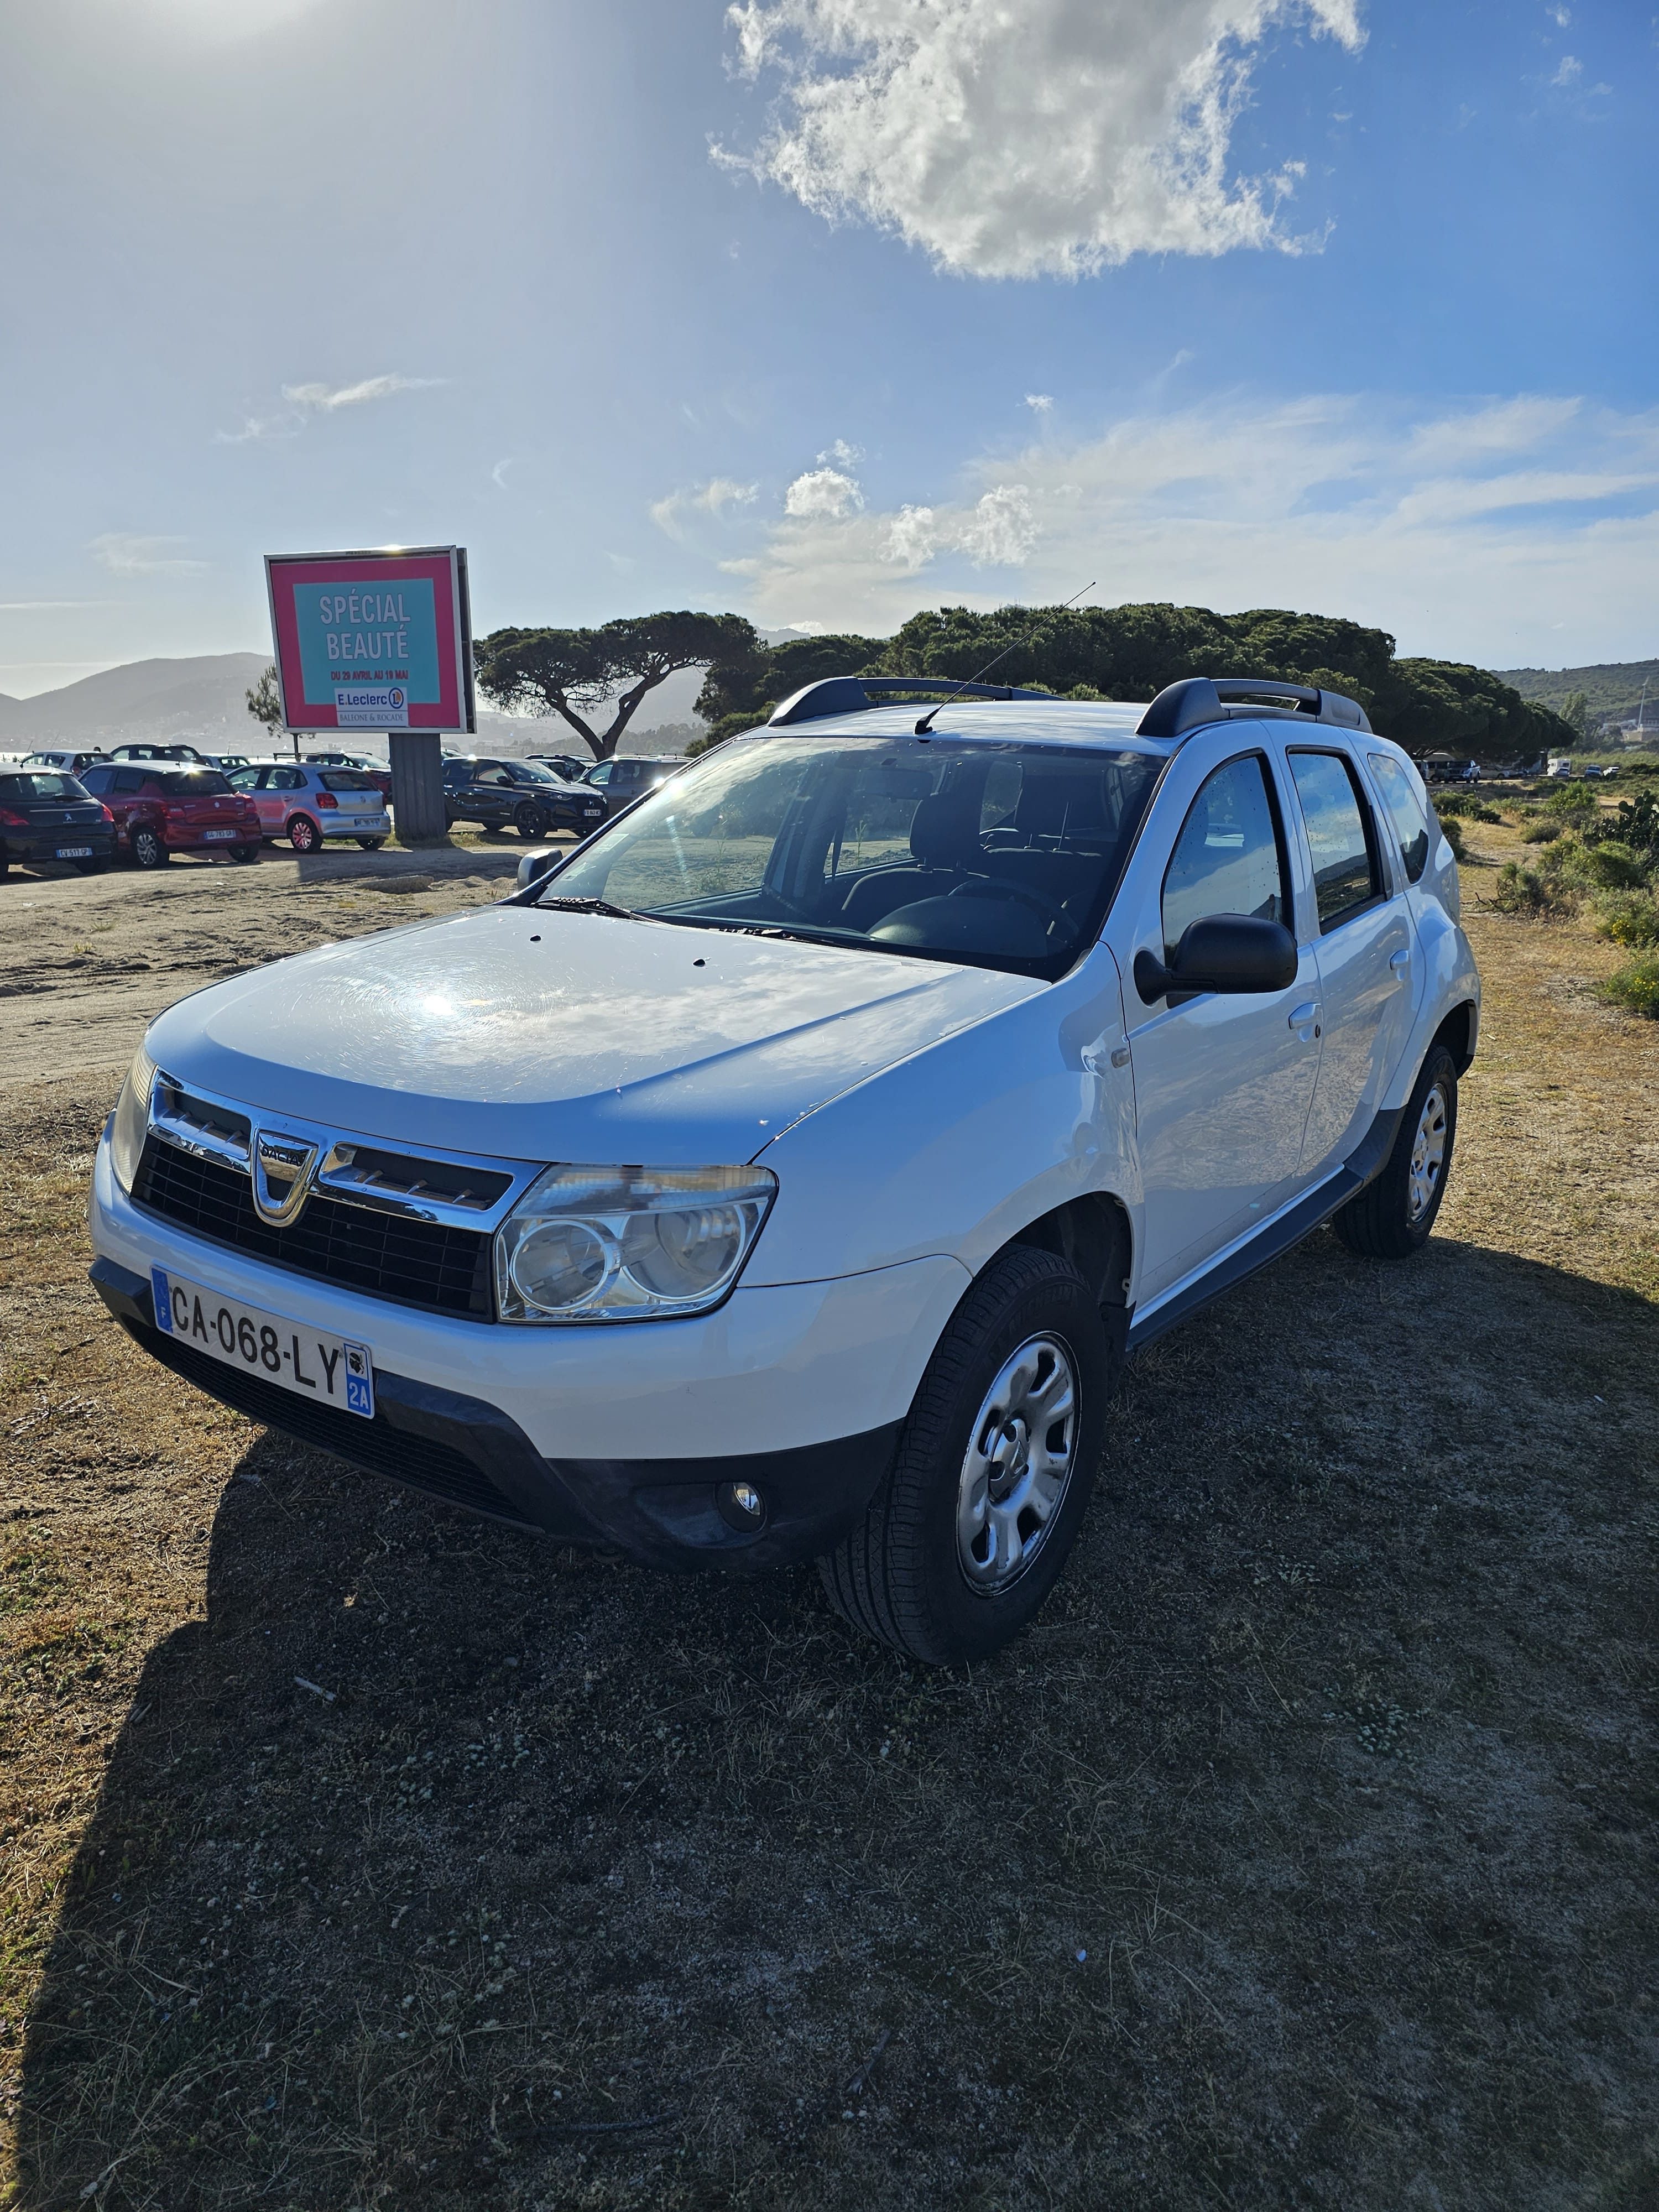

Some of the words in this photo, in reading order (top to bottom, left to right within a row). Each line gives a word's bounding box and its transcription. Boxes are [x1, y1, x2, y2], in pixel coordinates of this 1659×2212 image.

[319, 588, 411, 624] SPÉCIAL
[326, 624, 410, 660] BEAUTÉ
[331, 671, 341, 681] DU
[352, 670, 373, 680] AVRIL
[374, 670, 383, 680] AU
[395, 669, 409, 680] MAI
[338, 693, 387, 706] E.Leclerc
[369, 713, 375, 722] &
[260, 1145, 299, 1167] DACIA
[172, 1286, 340, 1395] CA-068-LY
[348, 1382, 369, 1410] 2A
